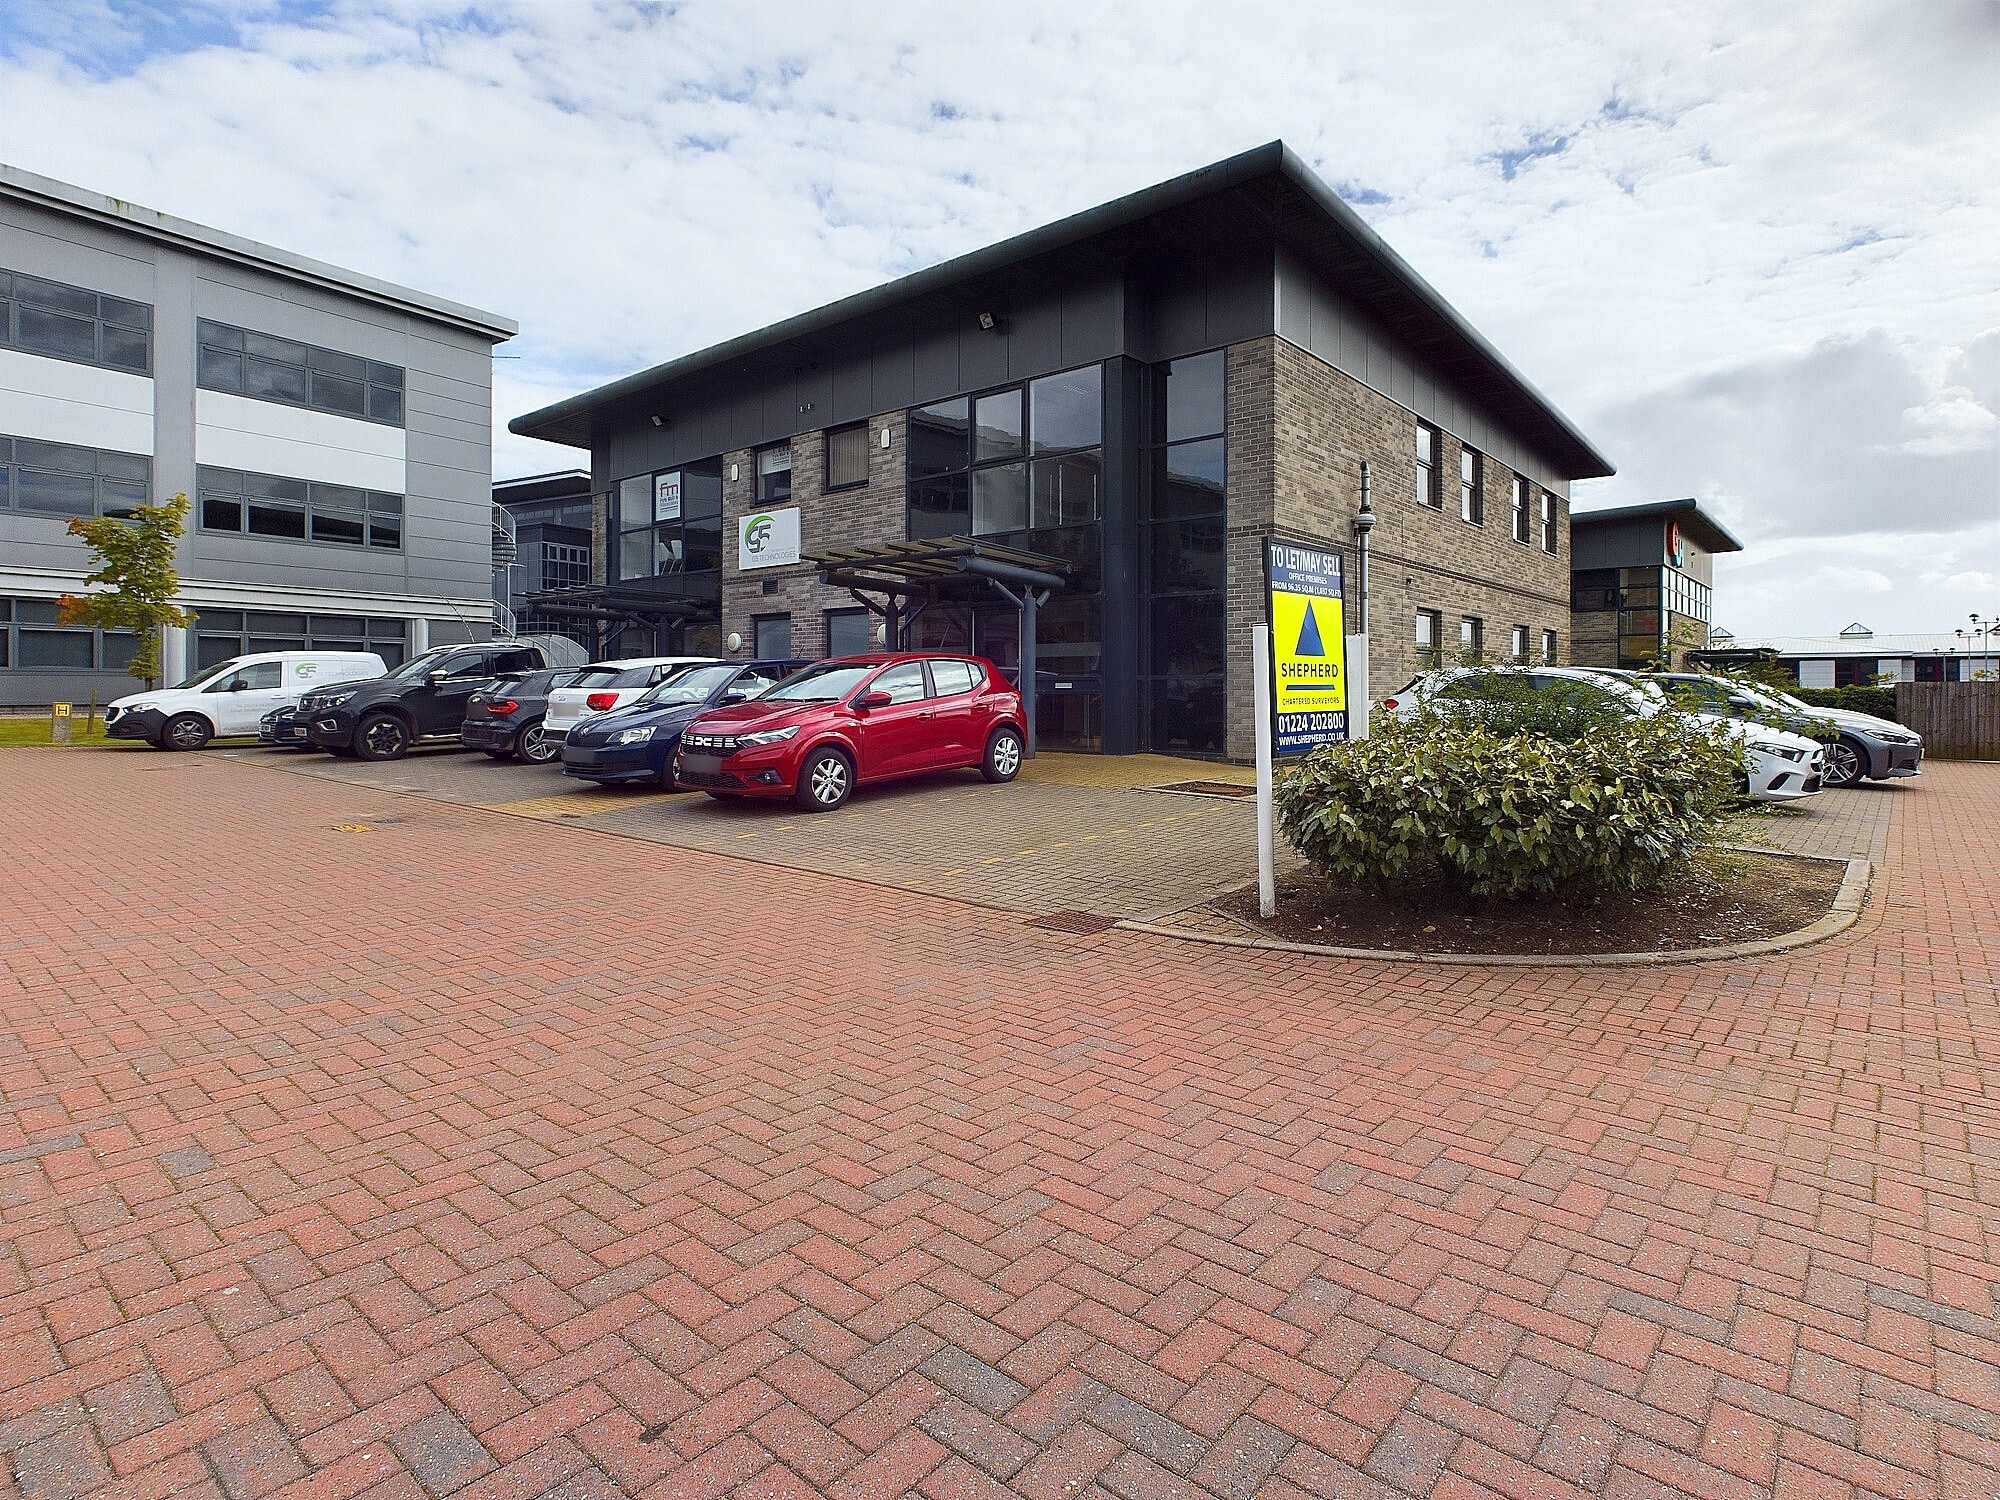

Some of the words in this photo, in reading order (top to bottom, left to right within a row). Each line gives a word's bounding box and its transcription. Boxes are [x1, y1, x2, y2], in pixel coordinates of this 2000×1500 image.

[760, 550, 797, 562] TECHNOLOGIES
[1271, 546, 1283, 567] TO
[1286, 549, 1320, 573] LET/MAY
[1323, 555, 1340, 576] SELL
[1289, 572, 1305, 581] OFFICE
[1306, 575, 1327, 584] PREMISES
[1272, 581, 1287, 589] FROM
[1281, 662, 1339, 678] SHEPHERD
[1282, 698, 1311, 706] CHARTERED
[1311, 696, 1340, 705] SURVEYORS
[57, 705, 68, 715] H
[1278, 715, 1308, 733] 01224
[1310, 713, 1344, 731] 202800
